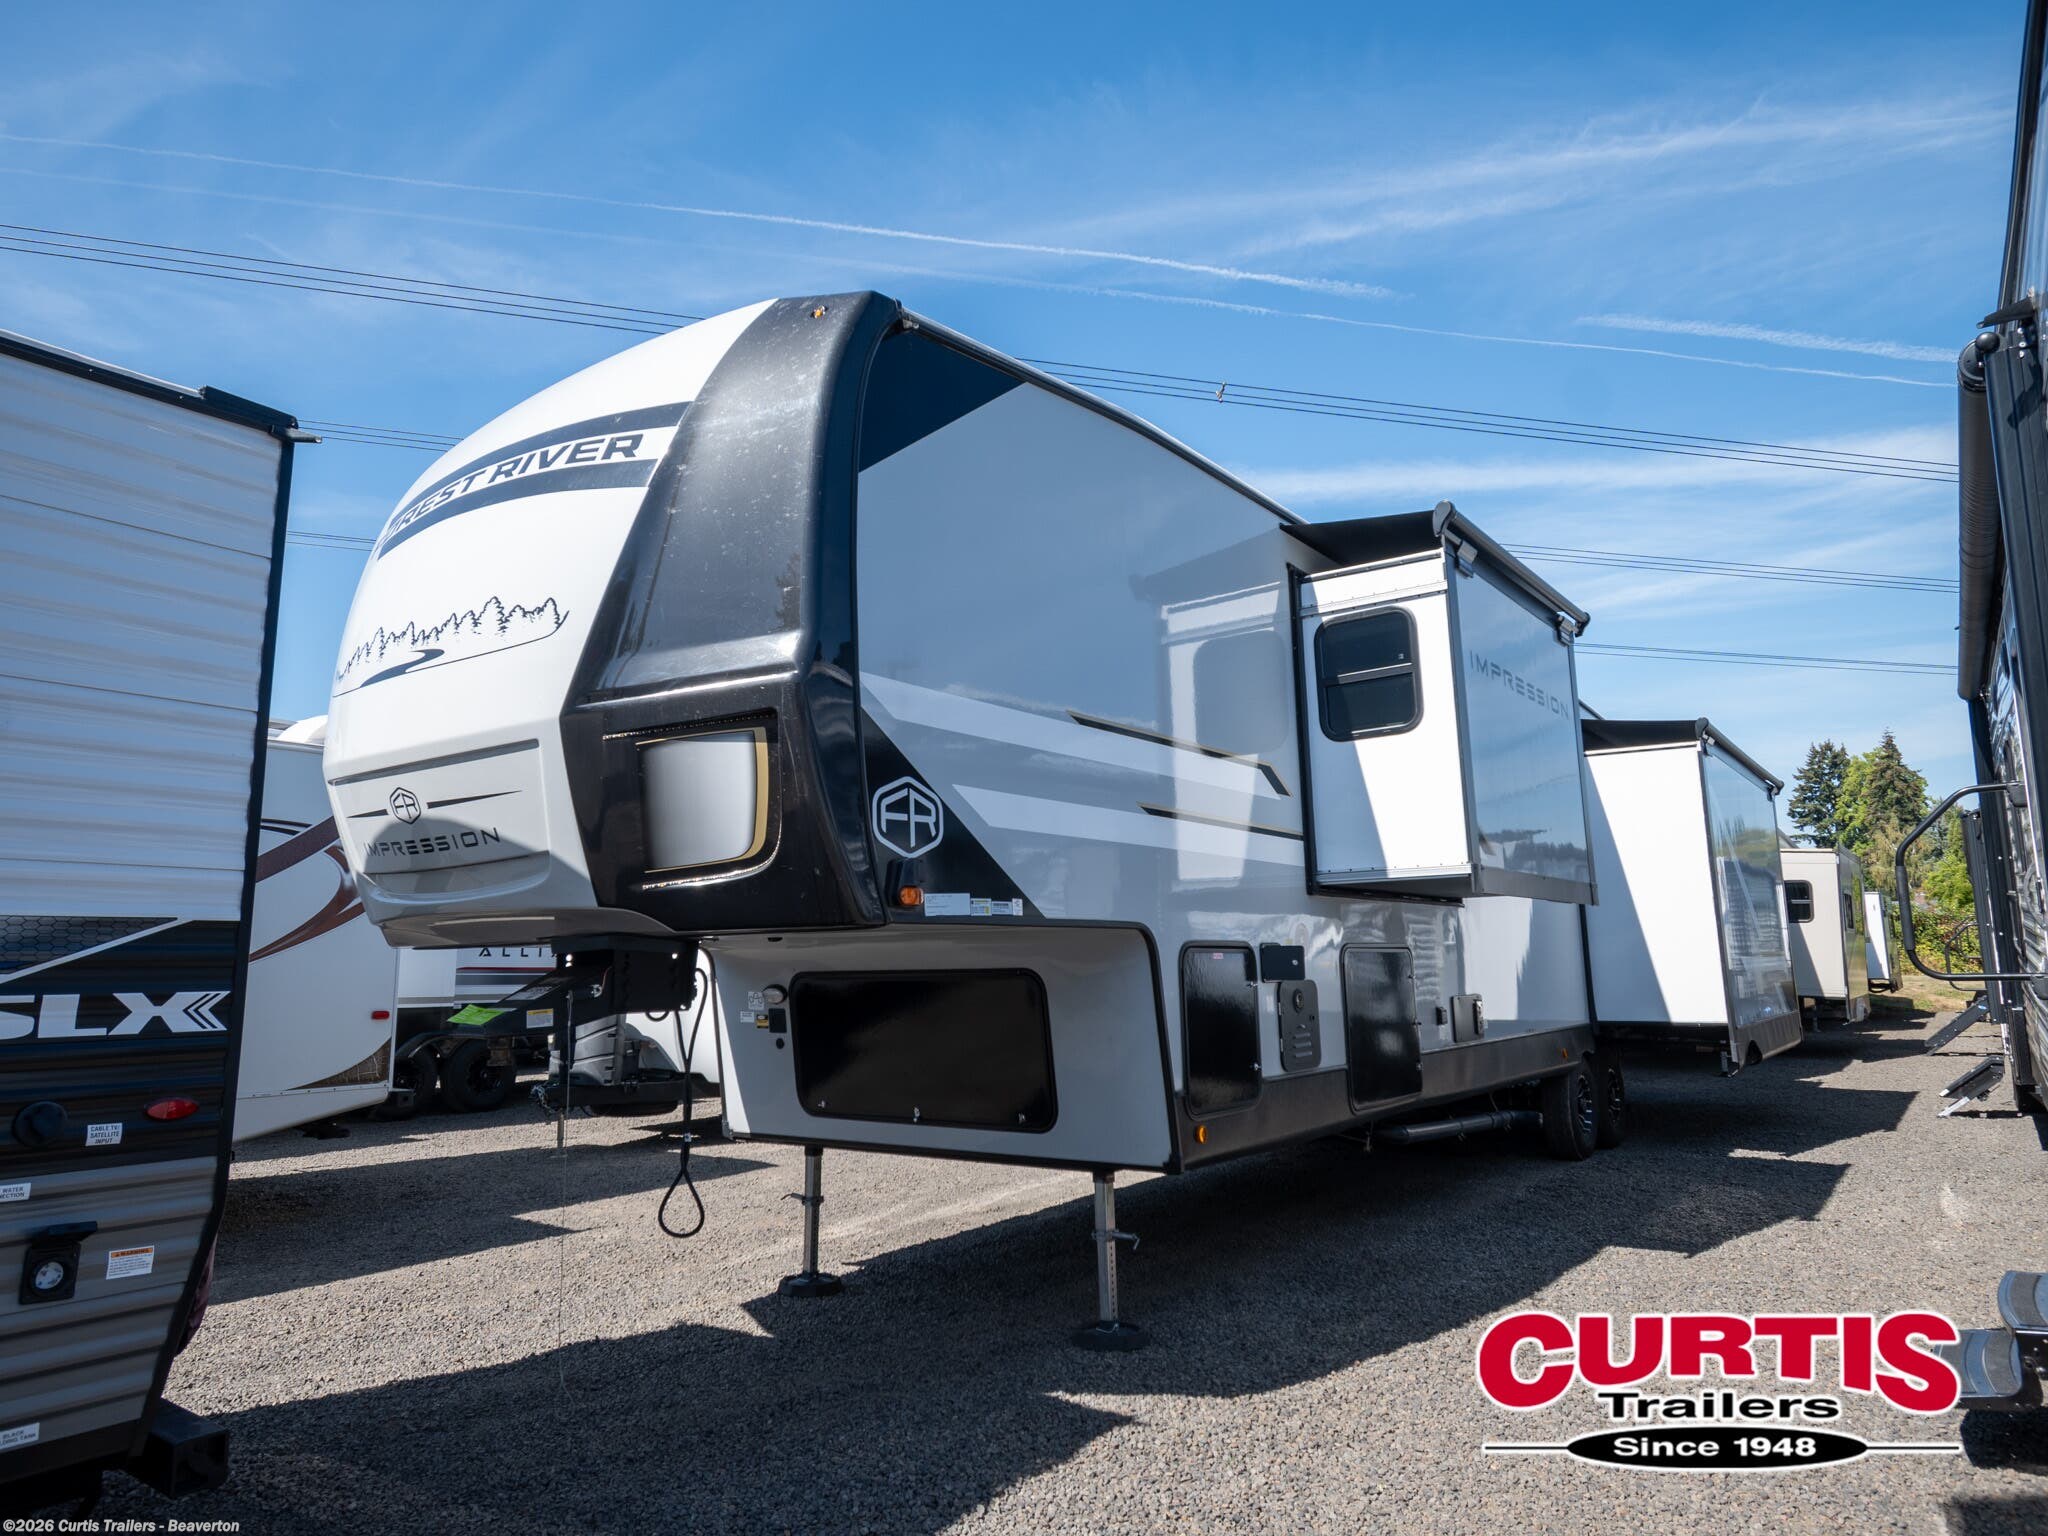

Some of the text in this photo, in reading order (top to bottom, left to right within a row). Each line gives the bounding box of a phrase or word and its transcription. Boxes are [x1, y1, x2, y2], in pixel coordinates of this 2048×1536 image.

[488, 434, 644, 484] RIVER
[1470, 649, 1569, 719] IMPRESSION
[363, 827, 501, 857] IMPRESSION
[479, 947, 557, 957] ALLI
